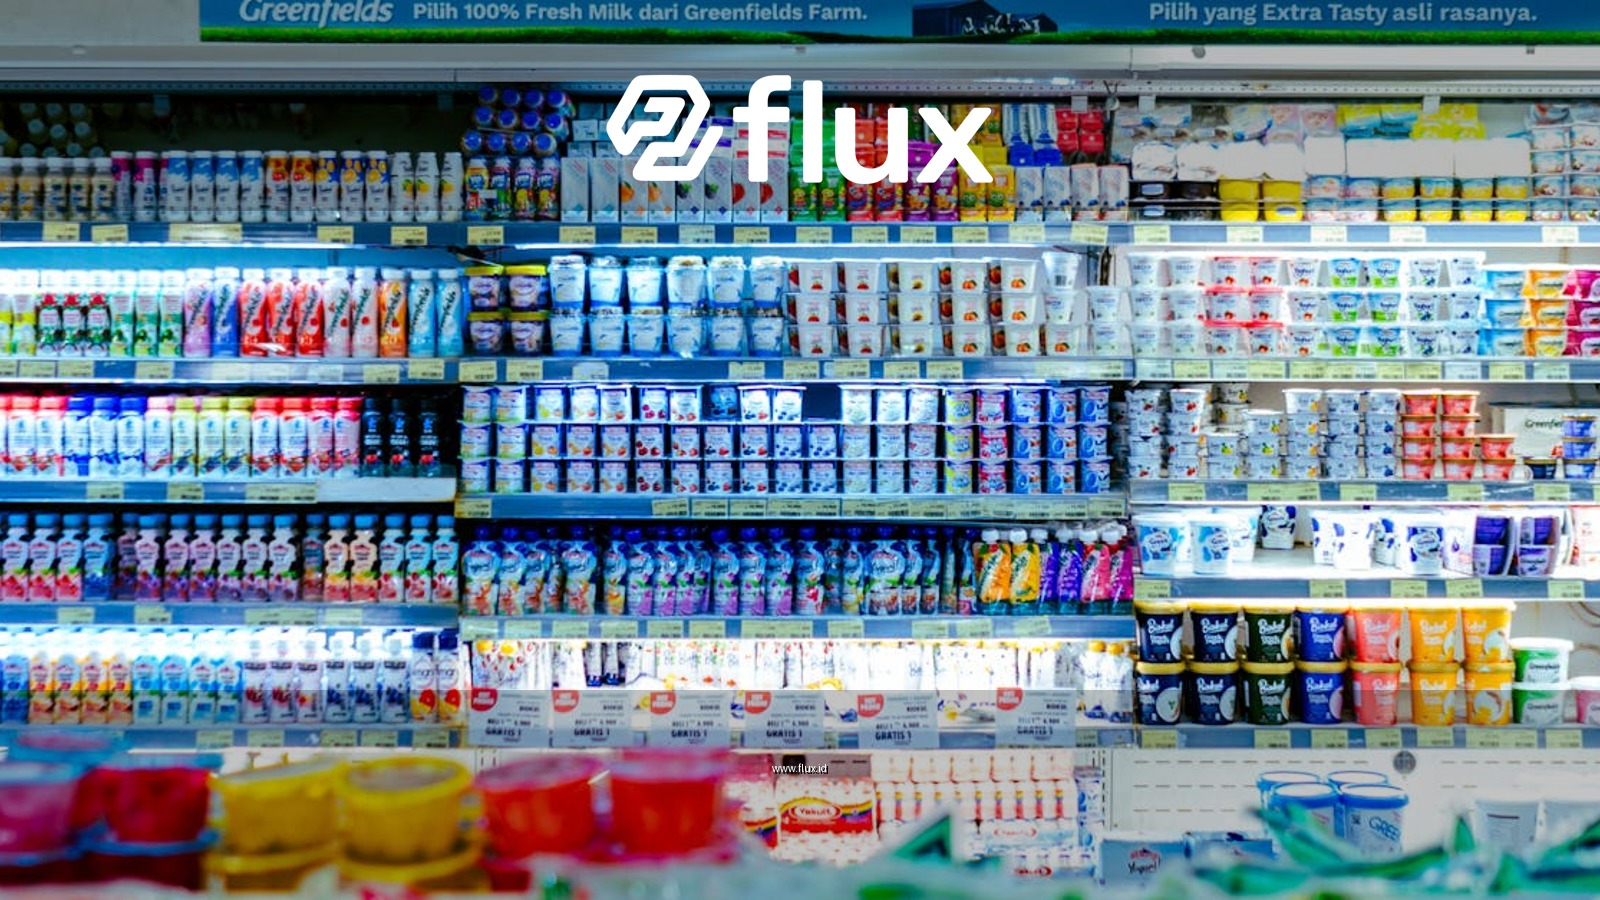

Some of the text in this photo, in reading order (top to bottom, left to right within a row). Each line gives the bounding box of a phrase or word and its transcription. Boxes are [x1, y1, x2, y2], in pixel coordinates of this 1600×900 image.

[238, 0, 395, 28] Greenfields
[413, 3, 868, 21] Pilih 100% Fresh Milk dari Greenfields Farm.
[1150, 3, 1538, 26] Pilih yang Extra Tasty asli rasanya.
[875, 731, 905, 740] GRATIS
[1017, 726, 1047, 734] GRATIS
